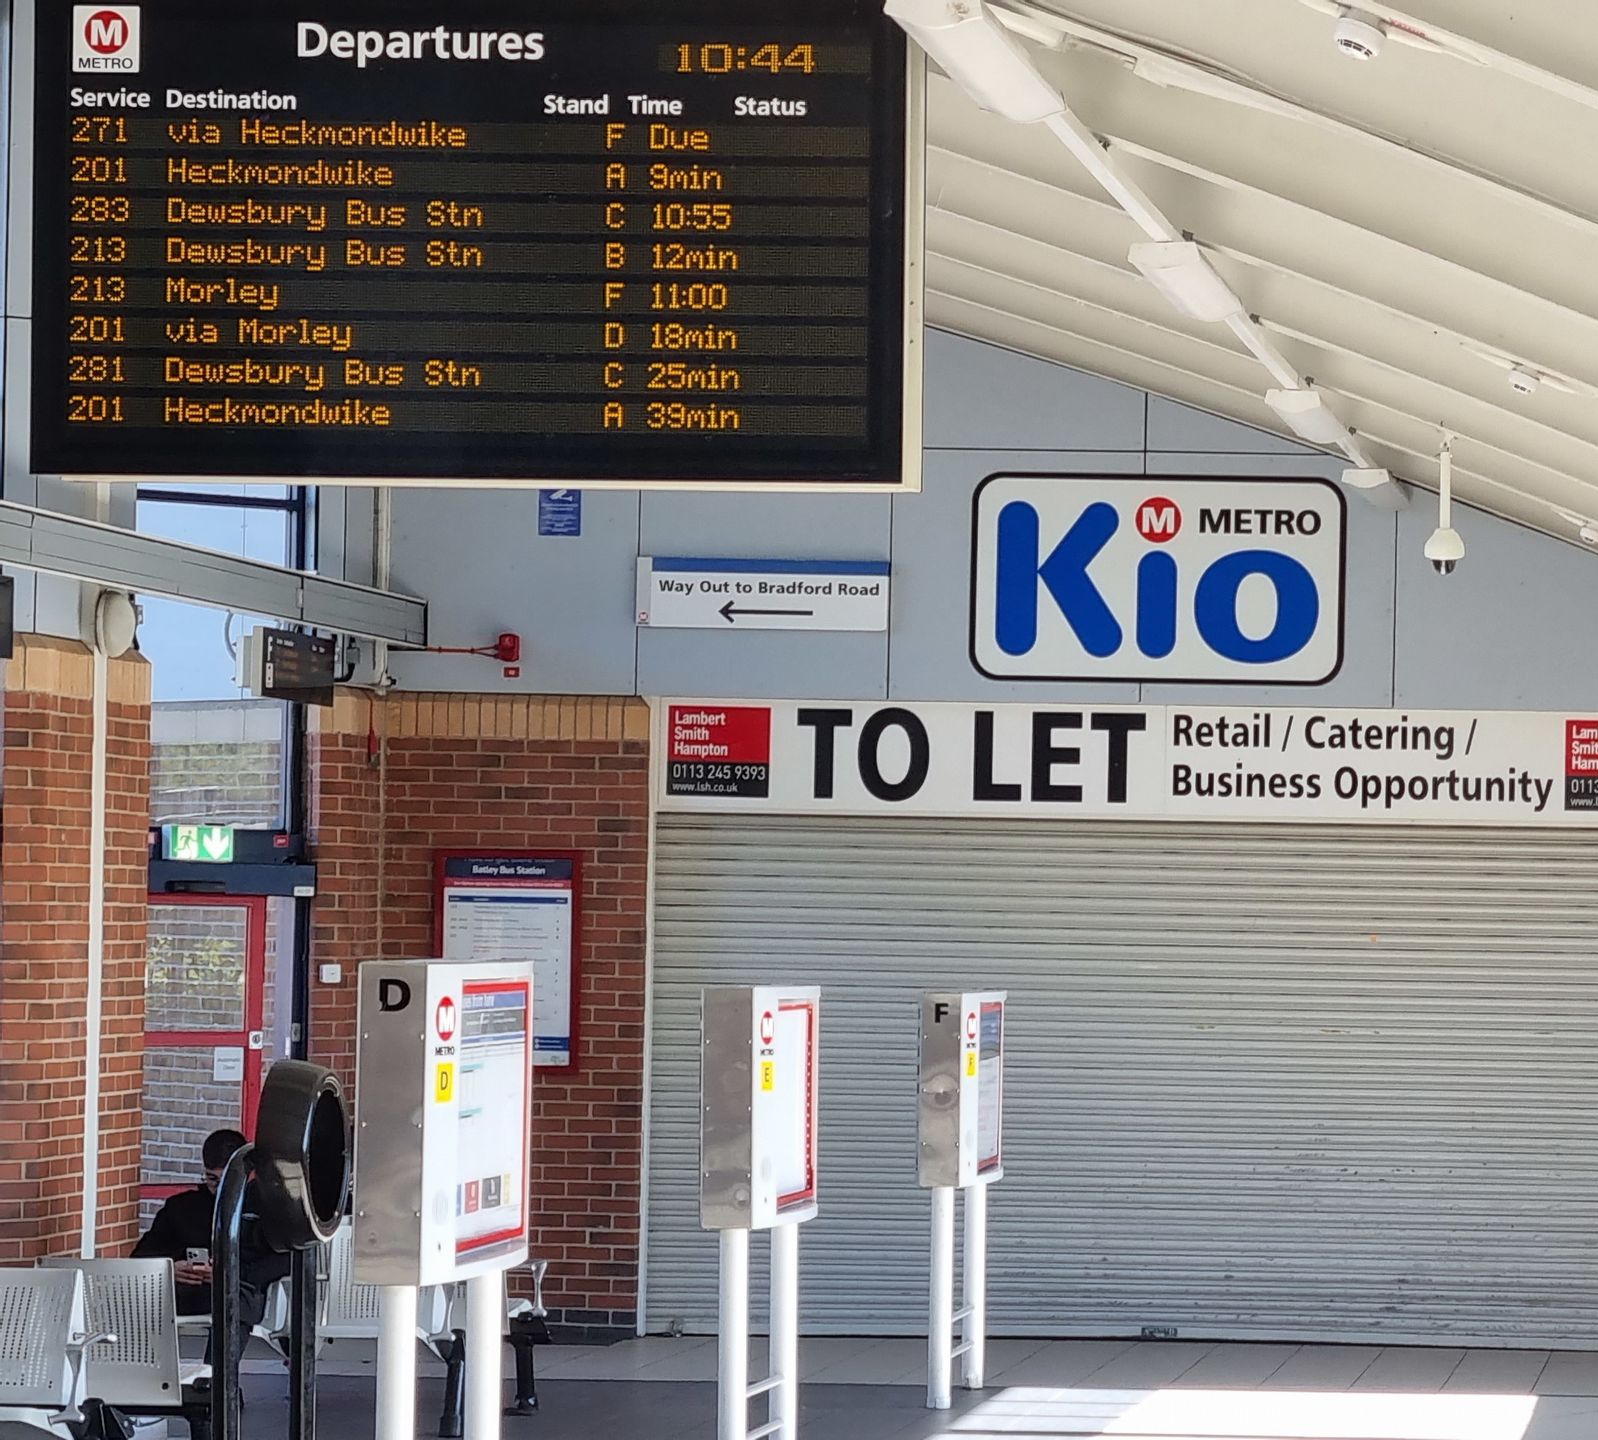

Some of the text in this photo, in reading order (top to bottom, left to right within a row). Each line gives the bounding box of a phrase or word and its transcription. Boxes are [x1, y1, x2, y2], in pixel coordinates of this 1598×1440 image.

[90, 20, 122, 47] M
[298, 23, 543, 67] Departures
[78, 57, 134, 69] METRO
[678, 44, 814, 72] 10:44
[71, 88, 806, 115] Service Destination Stand Time Status
[72, 117, 708, 149] 271 via Heckmondwike F Due
[73, 157, 721, 189] 201 Heckmondwike A 9min
[71, 197, 731, 230] 283 Dewsbury Bus Stn C 10:55
[71, 237, 737, 270] 213 Dewsbury Bus Stn B 12min
[71, 277, 727, 310] 213 Morley F 11:00
[70, 317, 736, 350] 201 via Morley D 18min
[69, 356, 739, 390] 281 Dewsbury Bus Stn C 25min
[68, 396, 739, 428] 201 Heckmondwike A 39min
[1141, 506, 1321, 535] M METRO
[659, 580, 879, 595] Way Out to Bradford Road
[995, 499, 1321, 664] Kio
[675, 711, 726, 725] Lambert
[674, 726, 710, 741] Smith
[1174, 714, 1270, 747] Retail
[1282, 716, 1293, 751] /
[1305, 716, 1454, 759] Catering
[674, 742, 728, 758] Hampton
[798, 707, 1146, 802] TO LET
[672, 763, 766, 781] 0113 245 9393
[672, 782, 738, 793] www.lsh.co.uk
[1173, 763, 1553, 811] Business Opportunity
[472, 865, 546, 876] Batley Bus Station
[379, 978, 411, 1012] D
[935, 1003, 949, 1023] F
[435, 1047, 455, 1056] METRO
[440, 1071, 449, 1090] D
